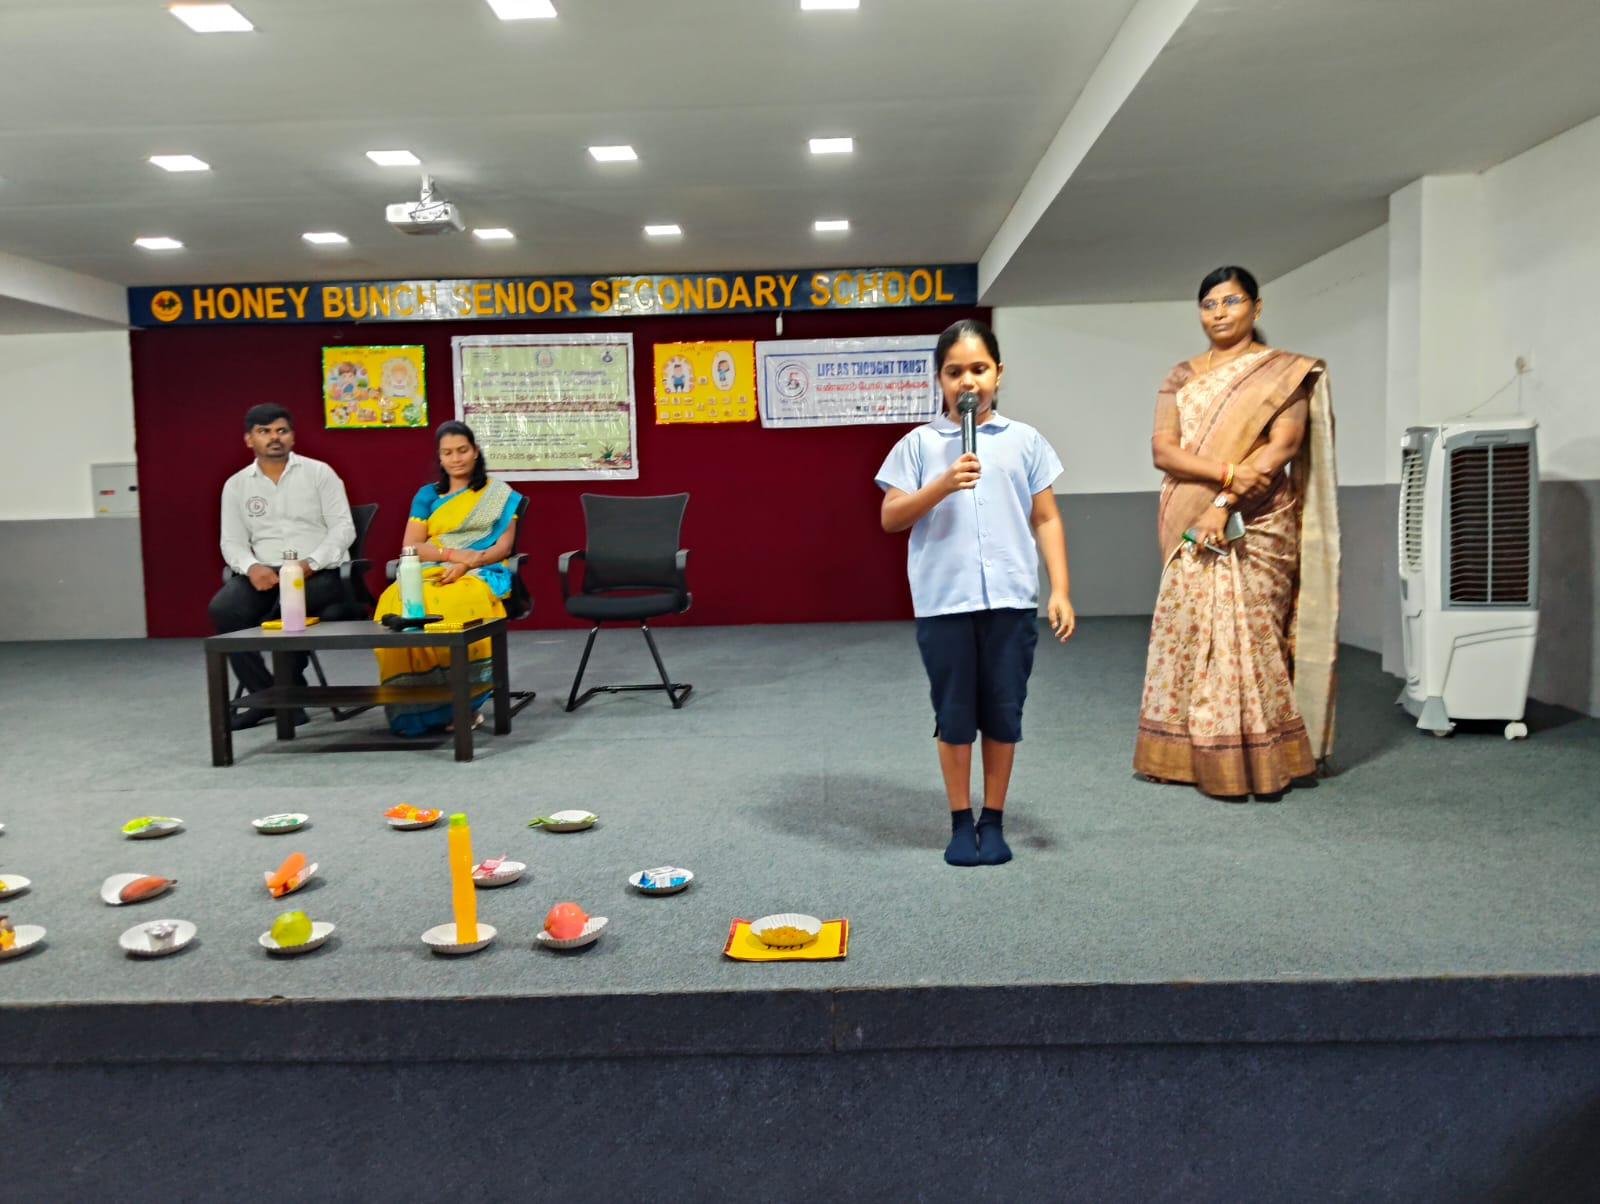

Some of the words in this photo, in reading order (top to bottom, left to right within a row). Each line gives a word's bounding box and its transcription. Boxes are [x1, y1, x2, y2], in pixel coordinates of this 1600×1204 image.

[193, 286, 310, 320] HONEY
[322, 282, 437, 318] BUNCH
[453, 279, 576, 316] SENIOR
[590, 274, 799, 312] SECONDARY
[810, 269, 954, 306] SCHOOL
[817, 362, 834, 376] LIFE
[837, 362, 849, 376] AS
[851, 360, 894, 375] THOUGHT
[898, 359, 927, 373] TRUST
